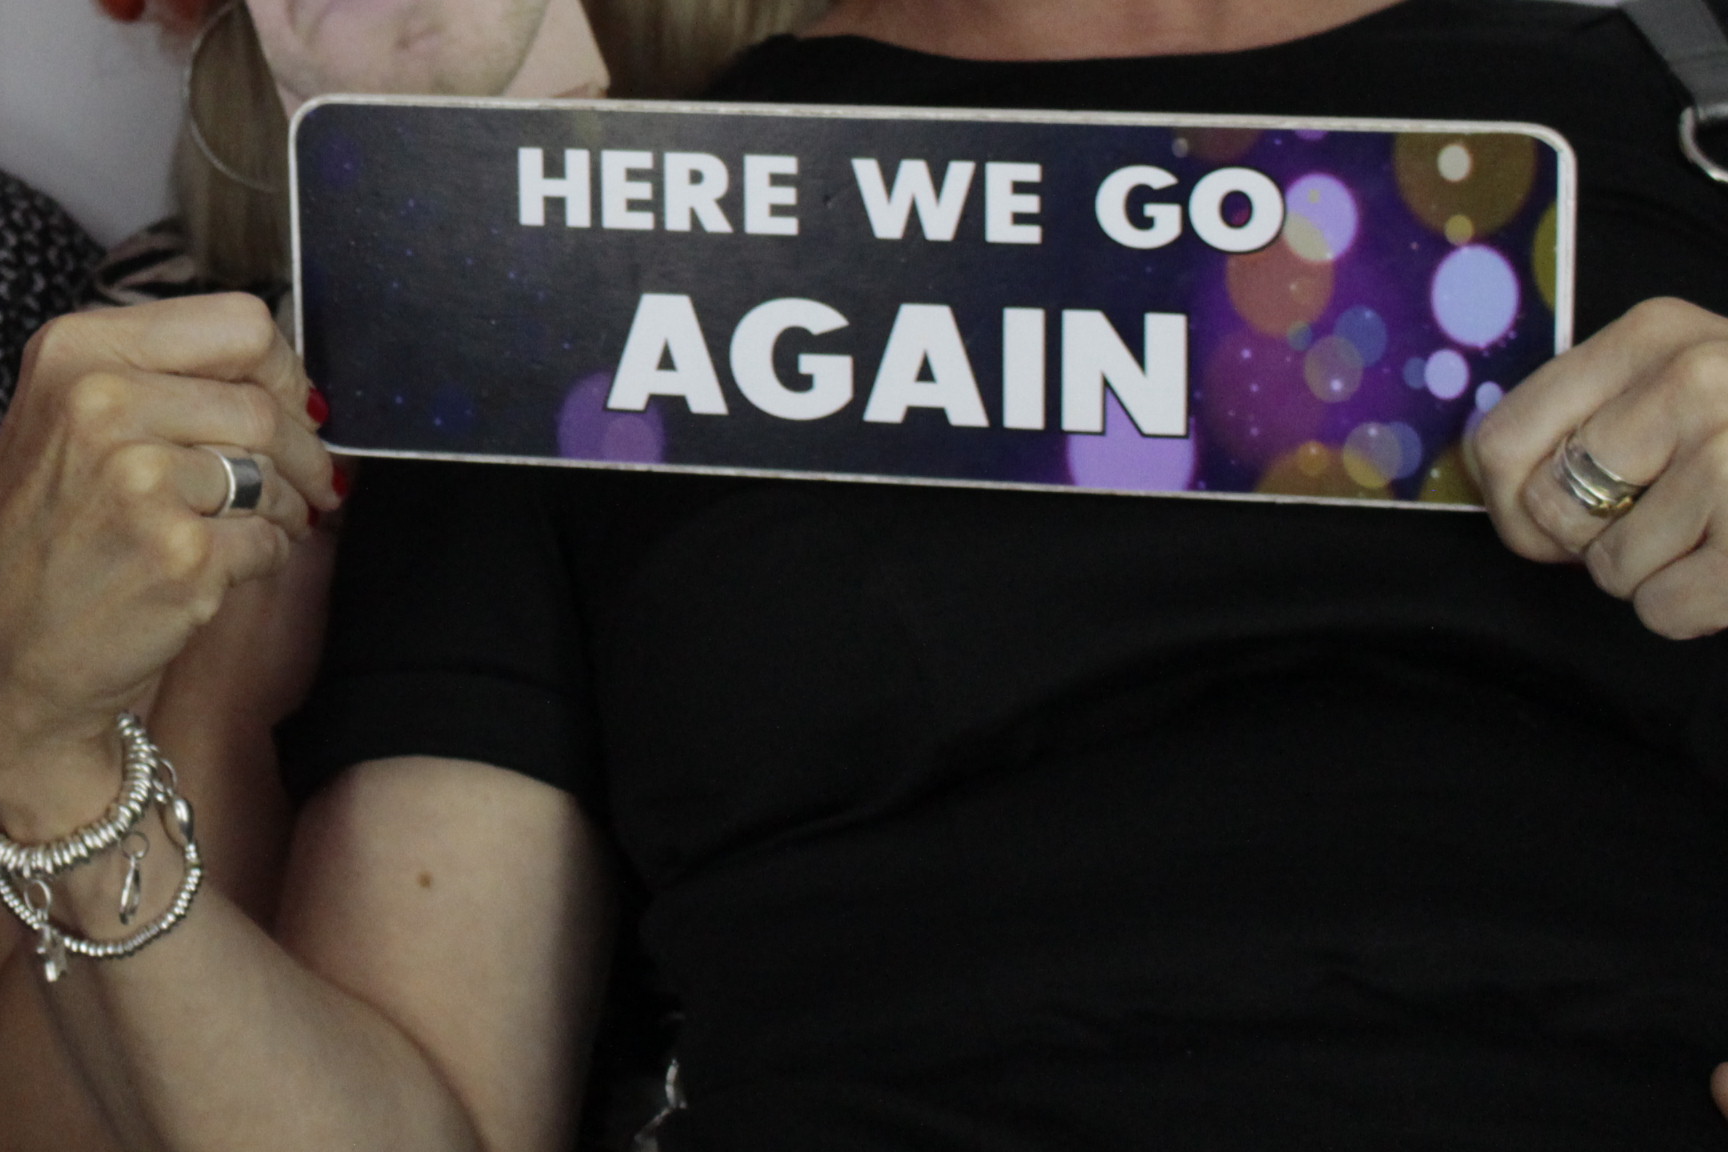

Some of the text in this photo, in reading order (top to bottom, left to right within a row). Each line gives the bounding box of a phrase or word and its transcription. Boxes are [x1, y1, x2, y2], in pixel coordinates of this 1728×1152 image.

[517, 147, 1285, 253] HERE WE GO
[605, 292, 1190, 437] AGAIN
